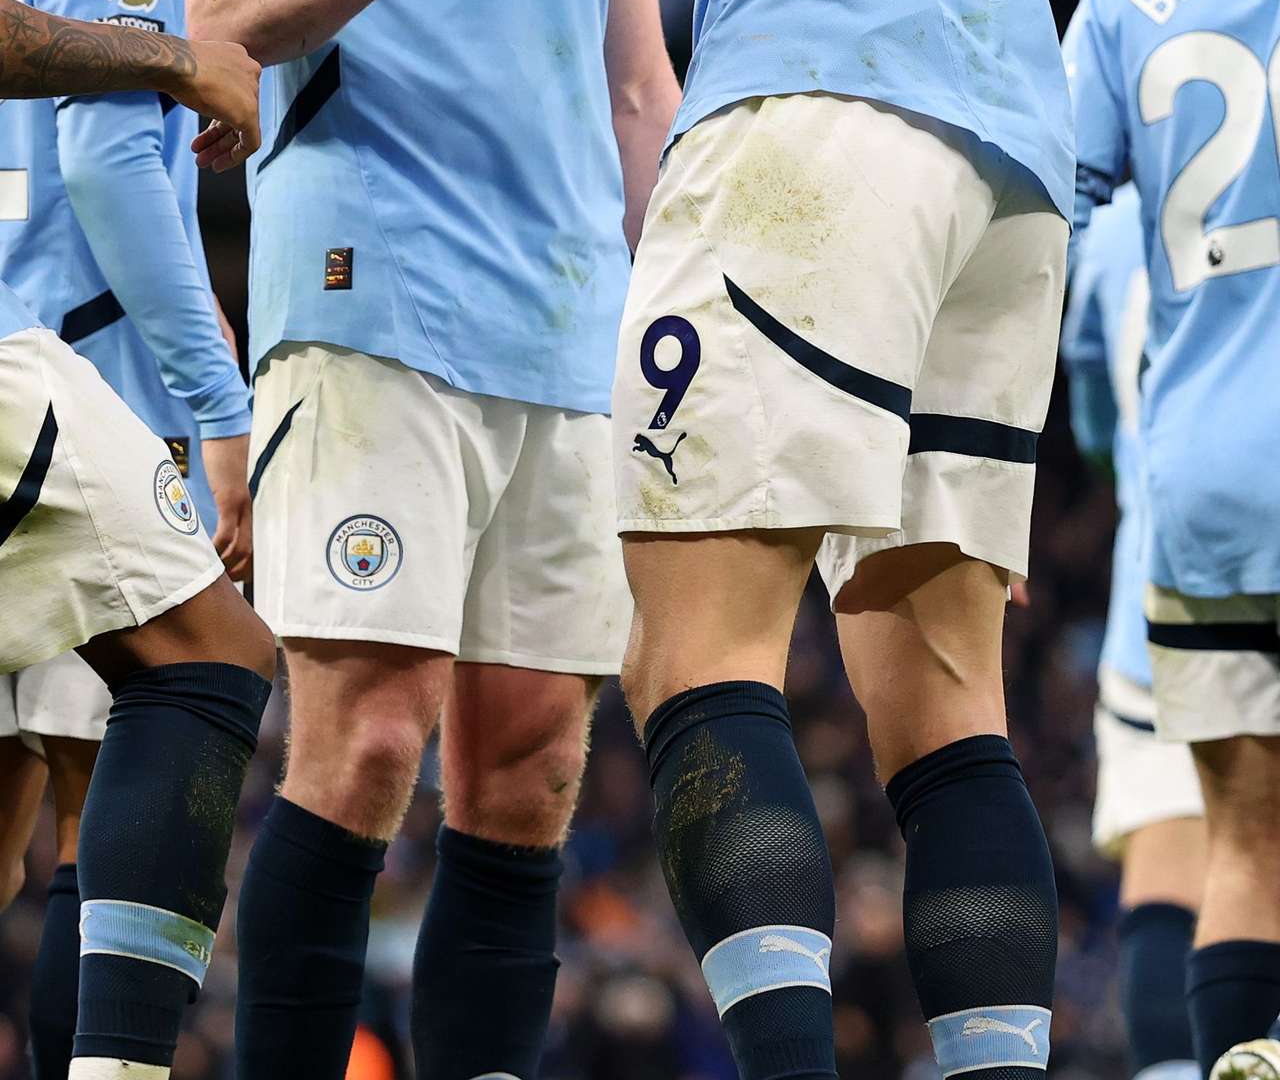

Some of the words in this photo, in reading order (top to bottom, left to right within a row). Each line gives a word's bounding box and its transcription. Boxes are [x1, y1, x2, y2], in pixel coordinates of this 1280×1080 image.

[640, 315, 701, 429] 9
[336, 520, 395, 545] MANCHESTER
[352, 578, 374, 587] CITY
